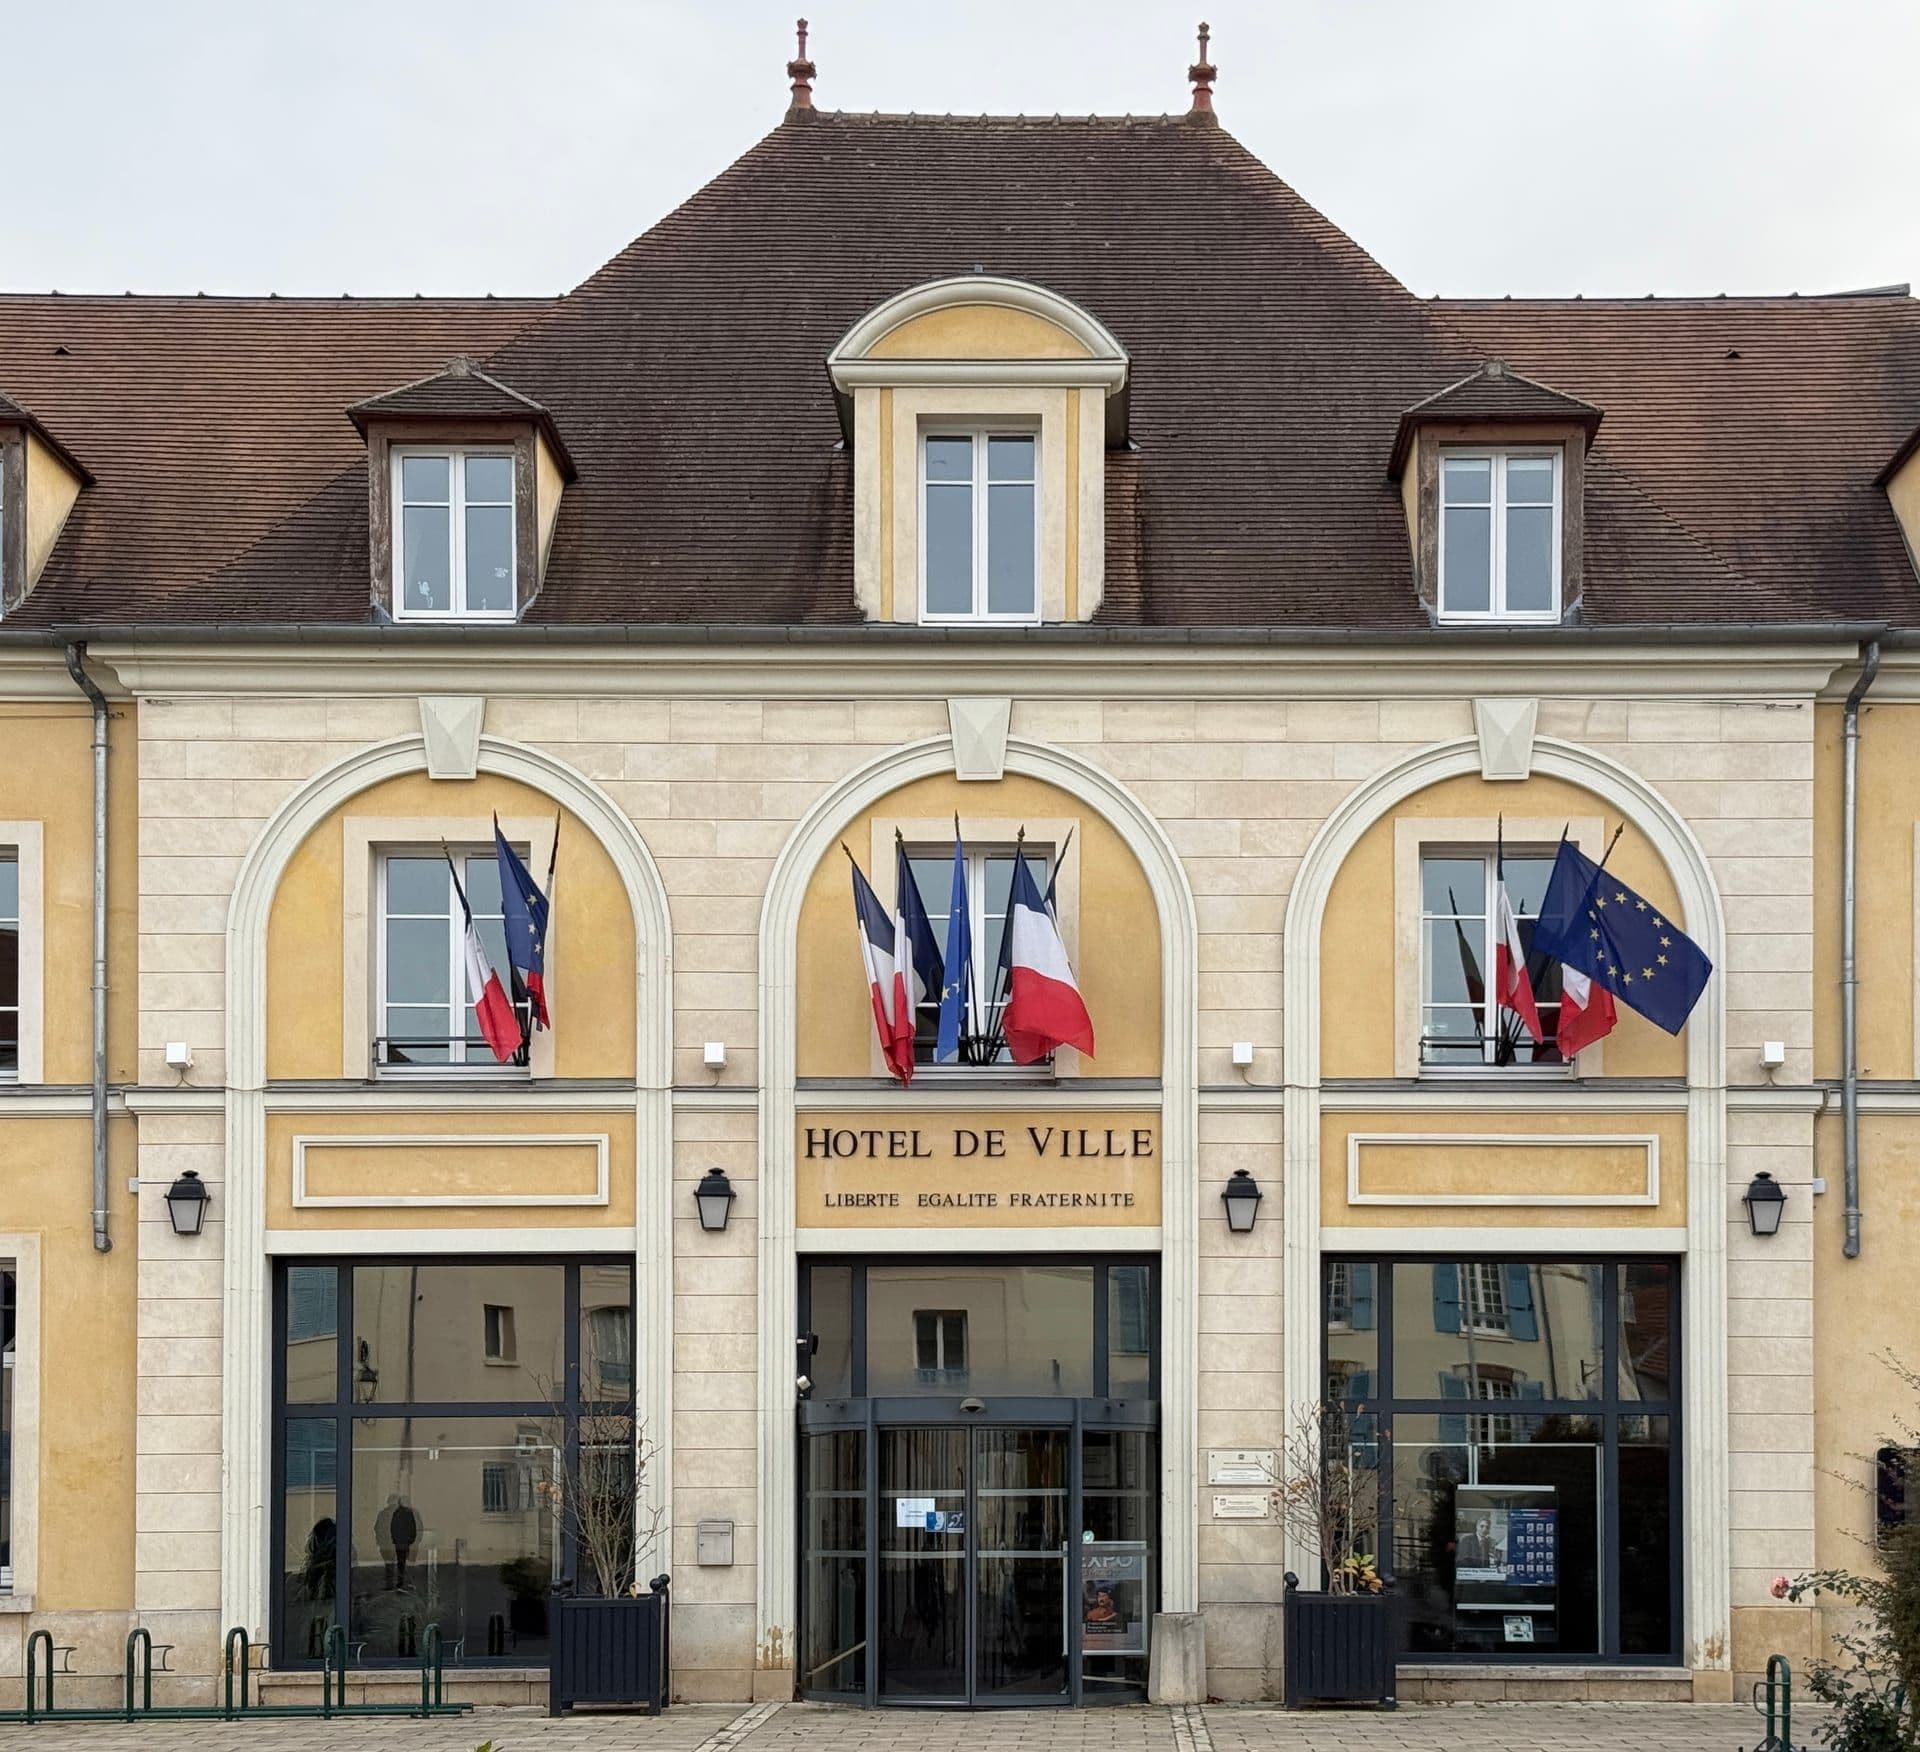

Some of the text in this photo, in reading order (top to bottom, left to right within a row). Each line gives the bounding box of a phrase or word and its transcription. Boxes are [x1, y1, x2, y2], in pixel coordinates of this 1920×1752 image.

[804, 1126, 1153, 1158] HOTEL DE VILLE
[824, 1193, 1135, 1207] LIBERTE EGALITE FRATERNITE
